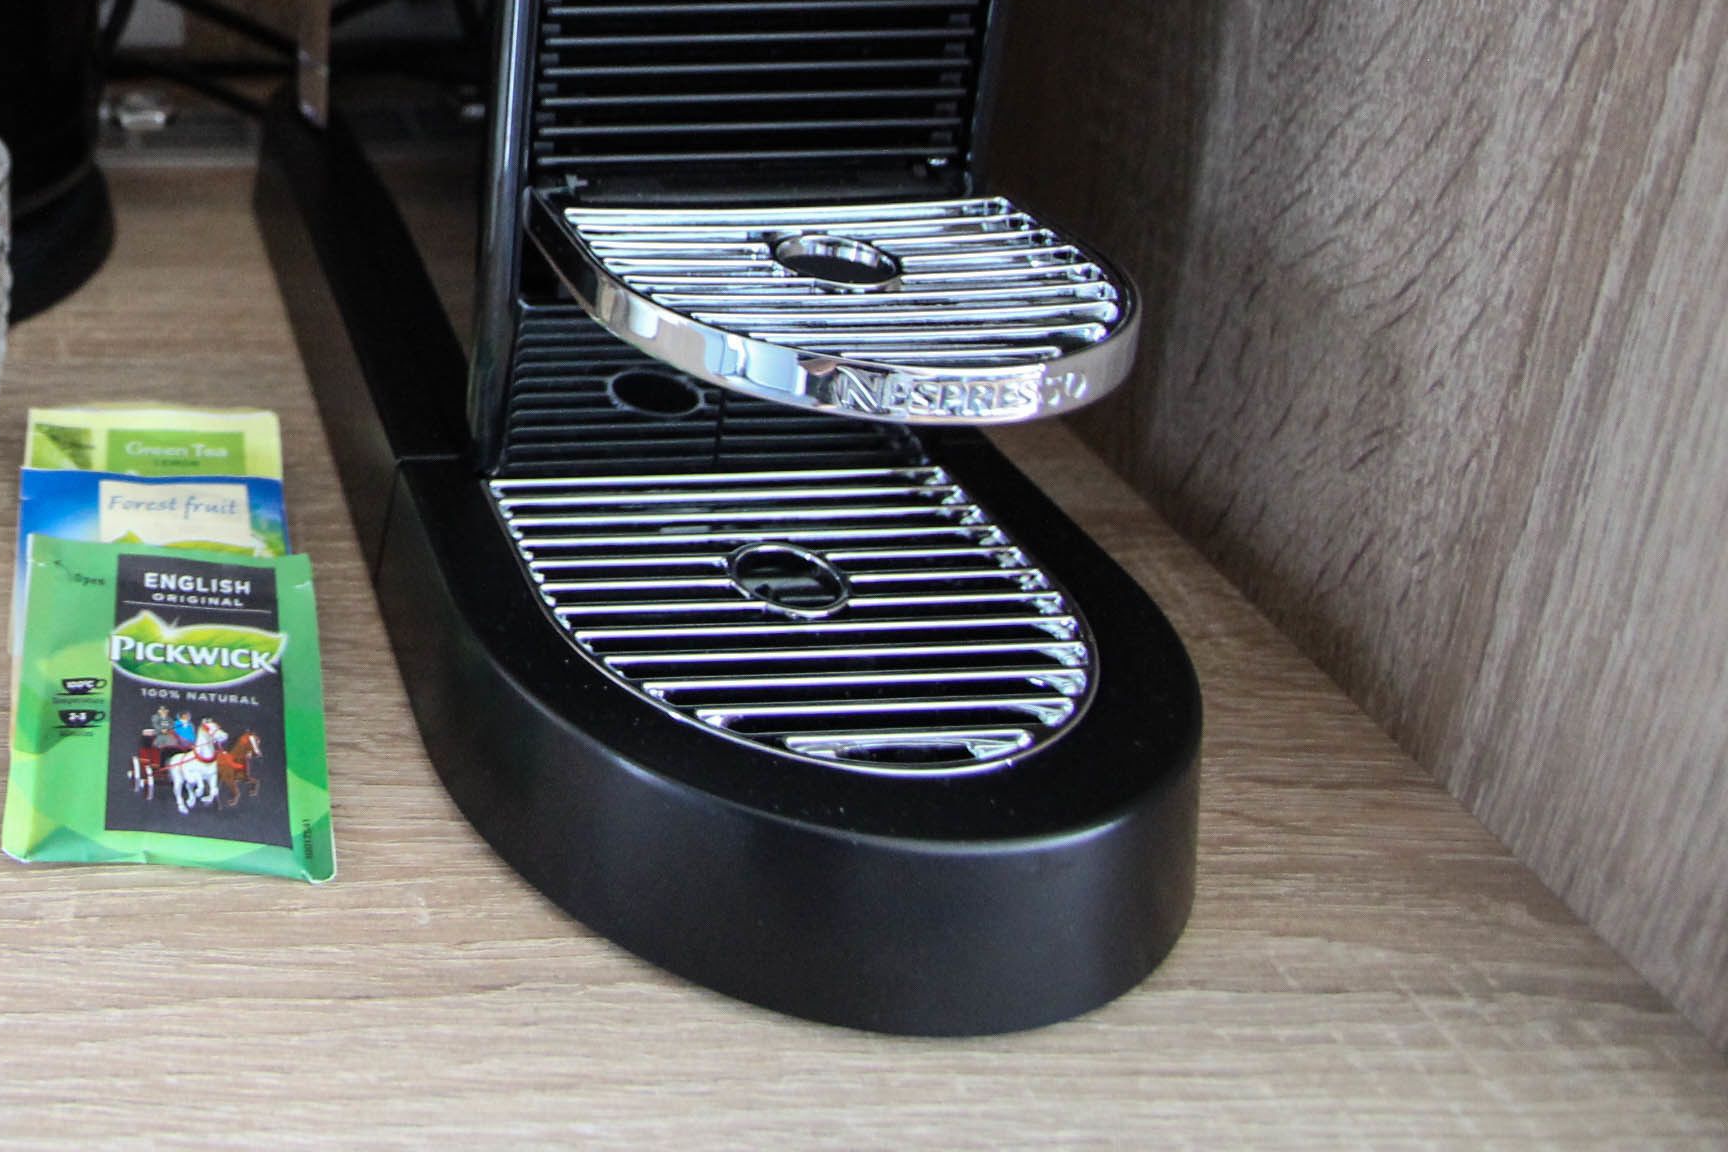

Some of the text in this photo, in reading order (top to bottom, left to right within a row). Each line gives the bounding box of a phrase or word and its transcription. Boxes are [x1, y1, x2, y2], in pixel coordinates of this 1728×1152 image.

[125, 440, 228, 457] Green Tea
[109, 495, 237, 520] Forest fruit
[144, 572, 251, 595] ENGLISH
[152, 593, 244, 607] ORIGINAL
[111, 635, 277, 674] PICKWICK
[140, 687, 260, 706] 100% NATURAL
